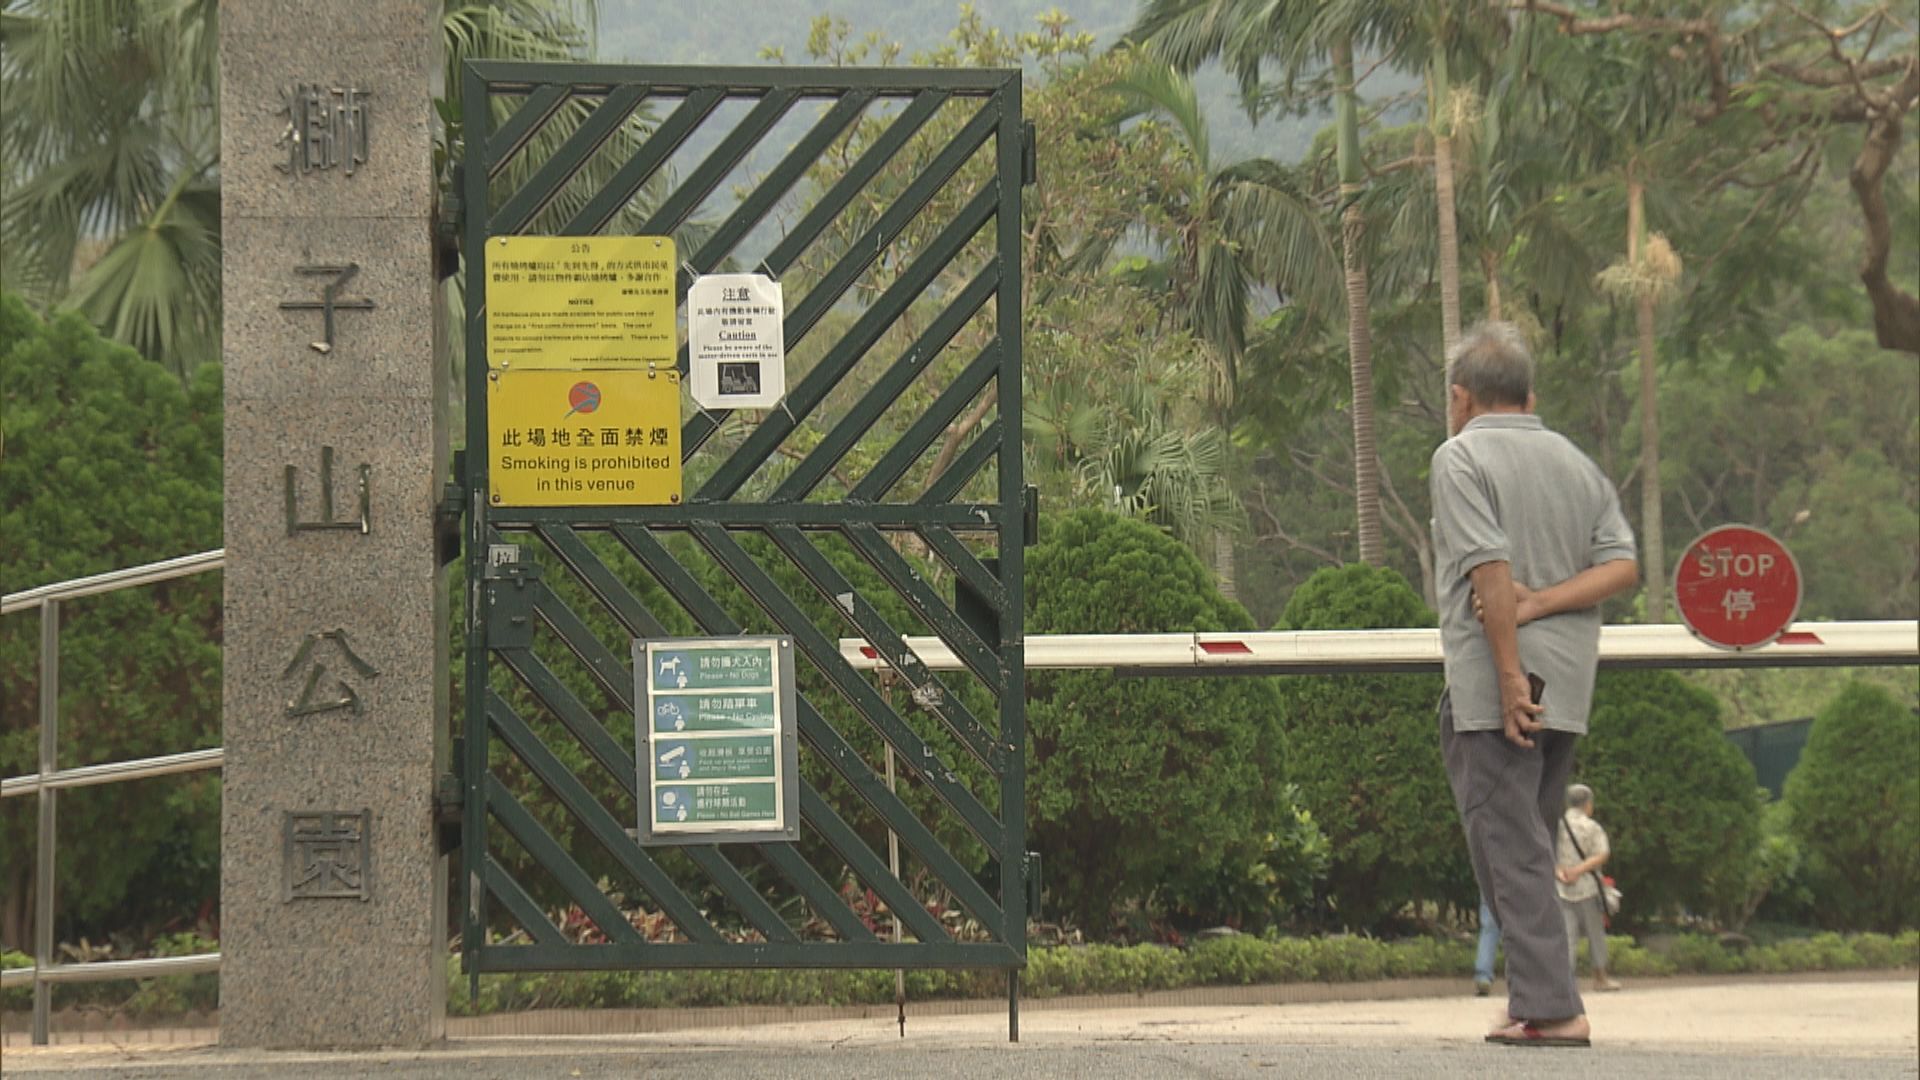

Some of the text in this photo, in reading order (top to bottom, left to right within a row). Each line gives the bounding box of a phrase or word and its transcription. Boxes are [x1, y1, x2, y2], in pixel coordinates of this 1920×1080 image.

[571, 243, 590, 254] 公告
[722, 286, 751, 301] 注意
[568, 298, 593, 306] NOTICE
[718, 330, 757, 341] Caution
[502, 427, 668, 447] 此場地全面禁煙
[501, 456, 670, 473] Smoking is prohibited
[537, 478, 635, 491] in this venue
[273, 83, 380, 902] 獅子山公園
[1699, 554, 1775, 577] STOP
[1721, 588, 1755, 620] 停
[700, 671, 723, 680] Please
[730, 671, 740, 679] No
[742, 671, 759, 680] Dogs
[699, 713, 725, 721] Please
[733, 713, 743, 721] No
